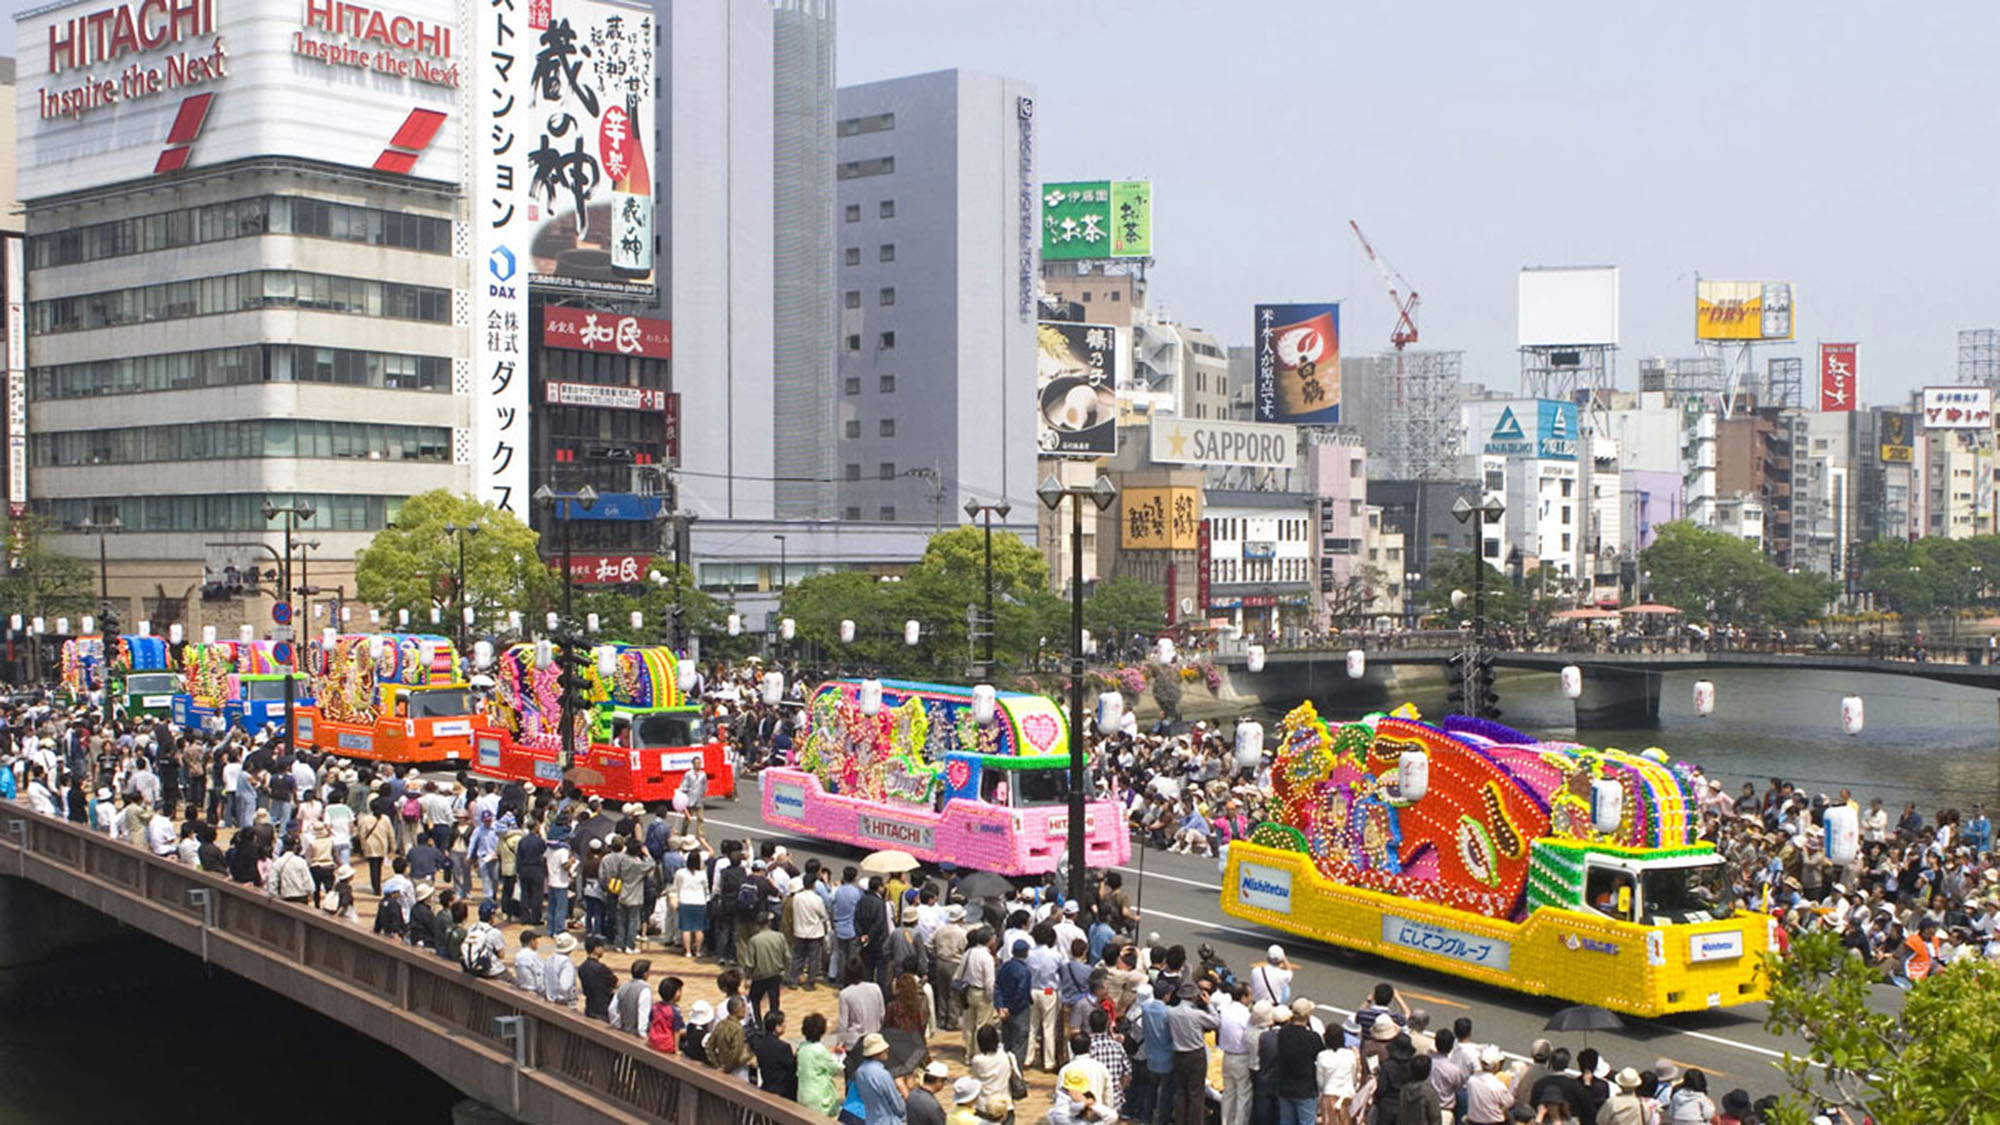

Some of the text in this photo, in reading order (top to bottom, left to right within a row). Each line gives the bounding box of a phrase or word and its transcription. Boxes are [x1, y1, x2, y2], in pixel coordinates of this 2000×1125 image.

[49, 0, 217, 74] HITACHI
[306, 0, 451, 58] HITACHI
[38, 40, 226, 119] Inspire the Next
[294, 32, 460, 88] Inspire the Next
[528, 18, 600, 240] 蔵の神
[620, 195, 643, 265] 蔵の神
[489, 284, 516, 299] DAX
[579, 313, 643, 354] 和民
[492, 361, 517, 512] ダックス
[1193, 429, 1285, 464] SAPPORO
[595, 557, 639, 582] 和民
[871, 819, 922, 844] HITACHI
[1049, 817, 1095, 830] HITHI
[1242, 876, 1290, 900] Nishitetsu
[1399, 926, 1492, 962] にしてつグループ
